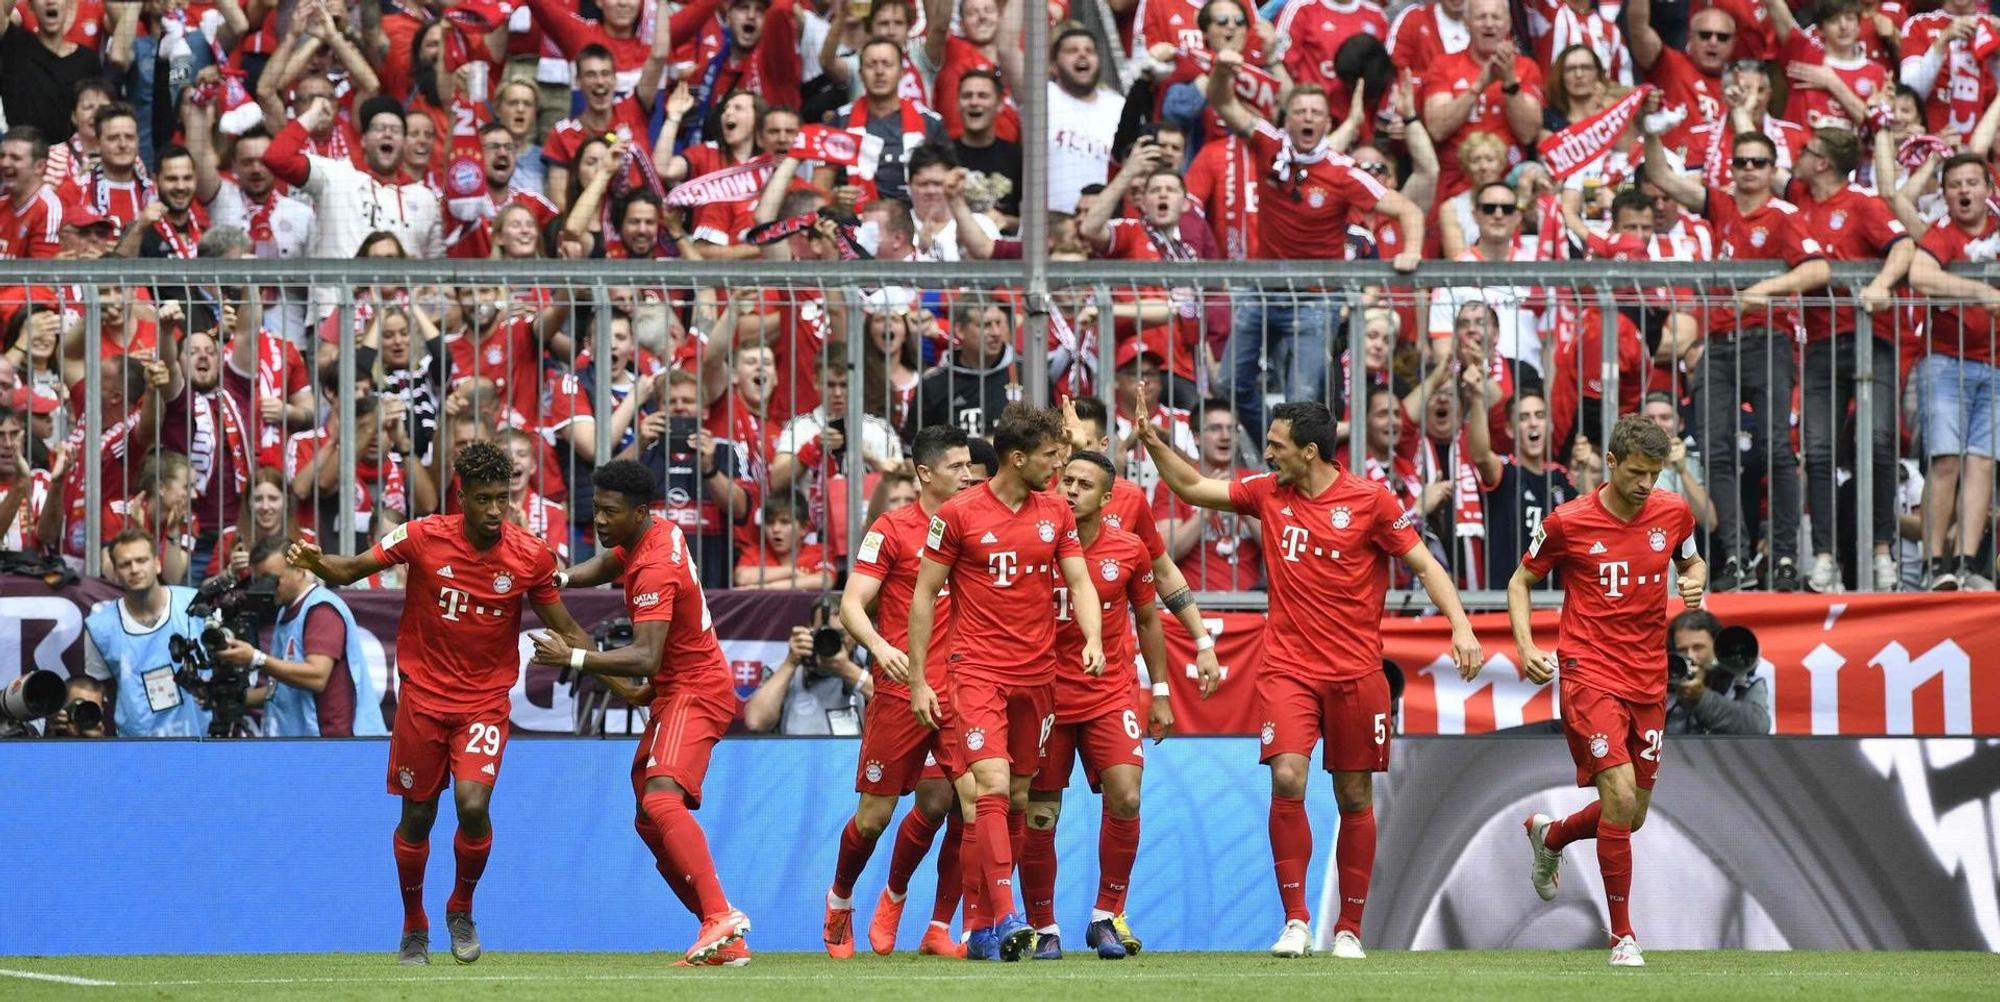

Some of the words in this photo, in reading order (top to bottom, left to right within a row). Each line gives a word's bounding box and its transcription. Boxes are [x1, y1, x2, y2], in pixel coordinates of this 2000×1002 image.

[1282, 525, 1308, 562] T
[989, 551, 1017, 587] T
[1600, 561, 1629, 598] T
[439, 586, 470, 622] T
[633, 592, 659, 605] QATAR
[465, 722, 500, 757] 29
[1038, 713, 1055, 750] 18
[1122, 709, 1140, 740] 6
[1374, 713, 1386, 745] 5
[1640, 729, 1664, 762] 25
